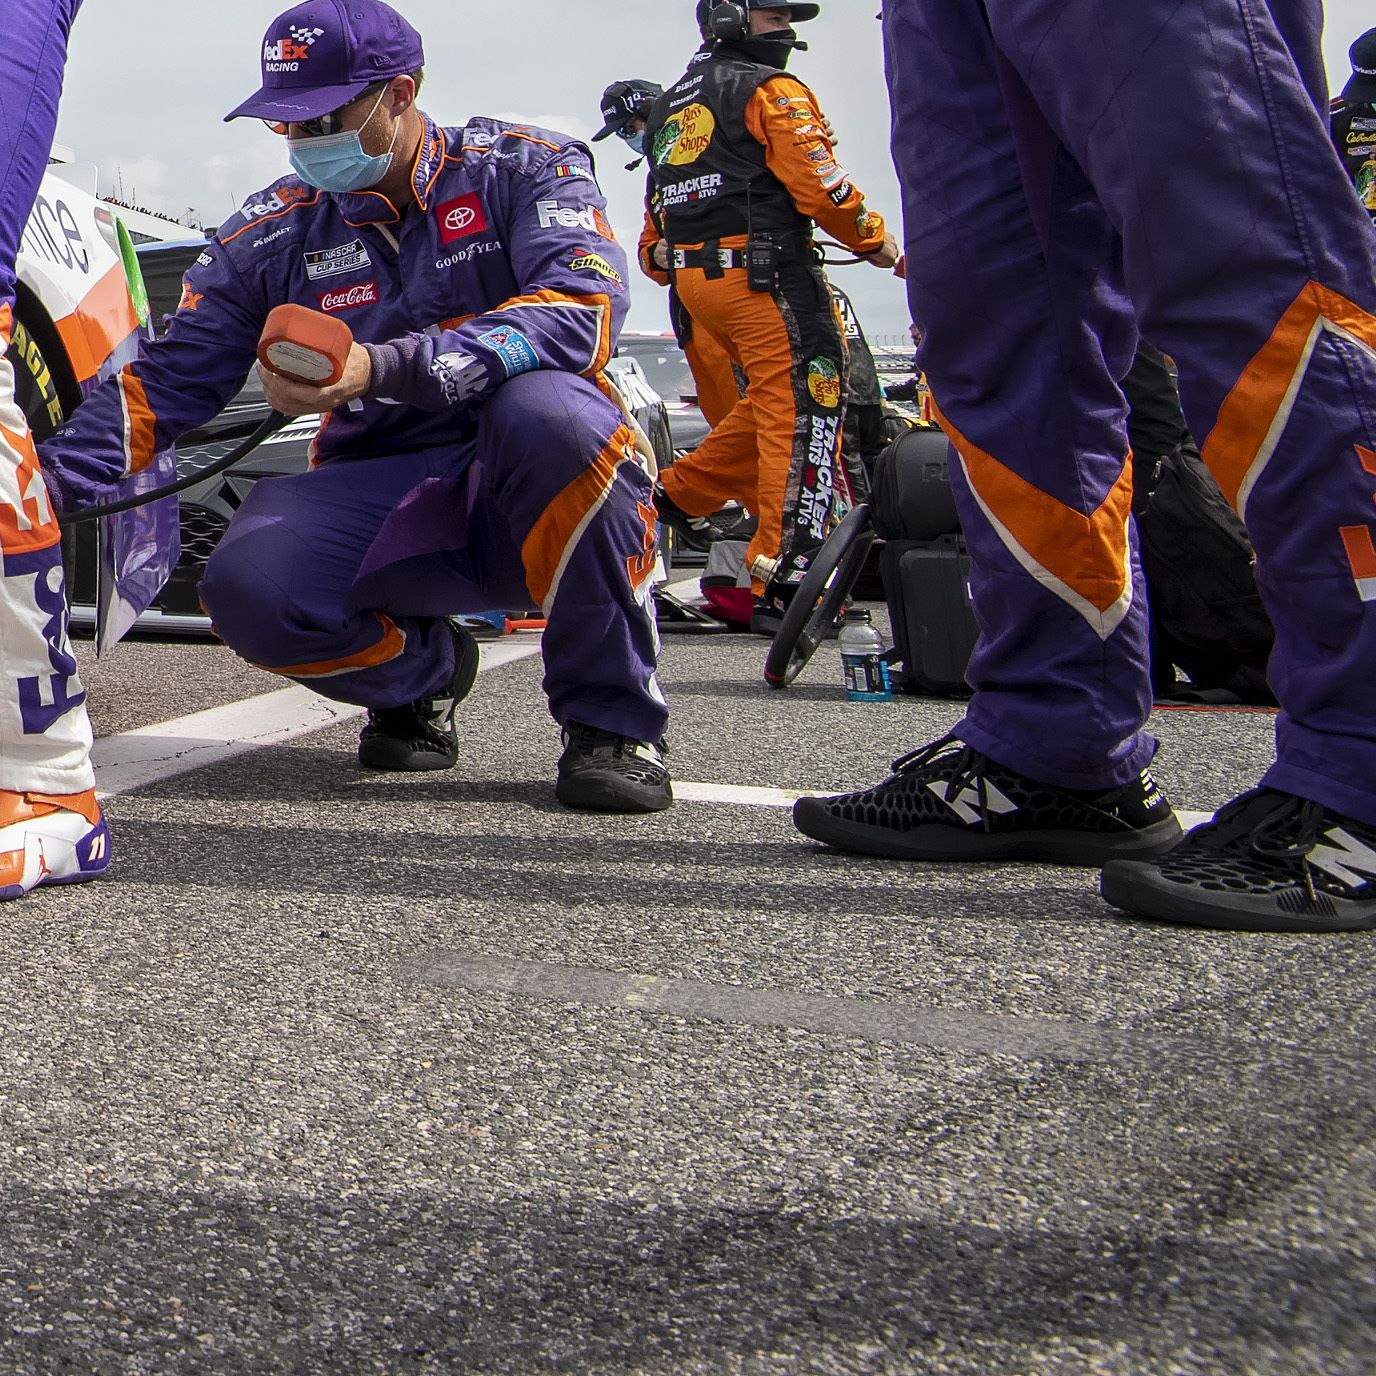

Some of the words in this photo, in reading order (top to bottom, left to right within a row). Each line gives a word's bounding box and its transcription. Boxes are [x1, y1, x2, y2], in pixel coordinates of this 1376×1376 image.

[264, 39, 309, 61] FedEx
[265, 61, 299, 72] RACING
[662, 173, 722, 199] TRACKER
[663, 193, 688, 206] BOATS
[316, 262, 332, 273] CUP
[333, 254, 361, 270] SERIES
[321, 283, 374, 310] Coca-Cola
[10, 320, 64, 427] AGLE
[809, 415, 825, 466] BOATS
[810, 415, 839, 541] TRACKER
[87, 832, 106, 862] 11
